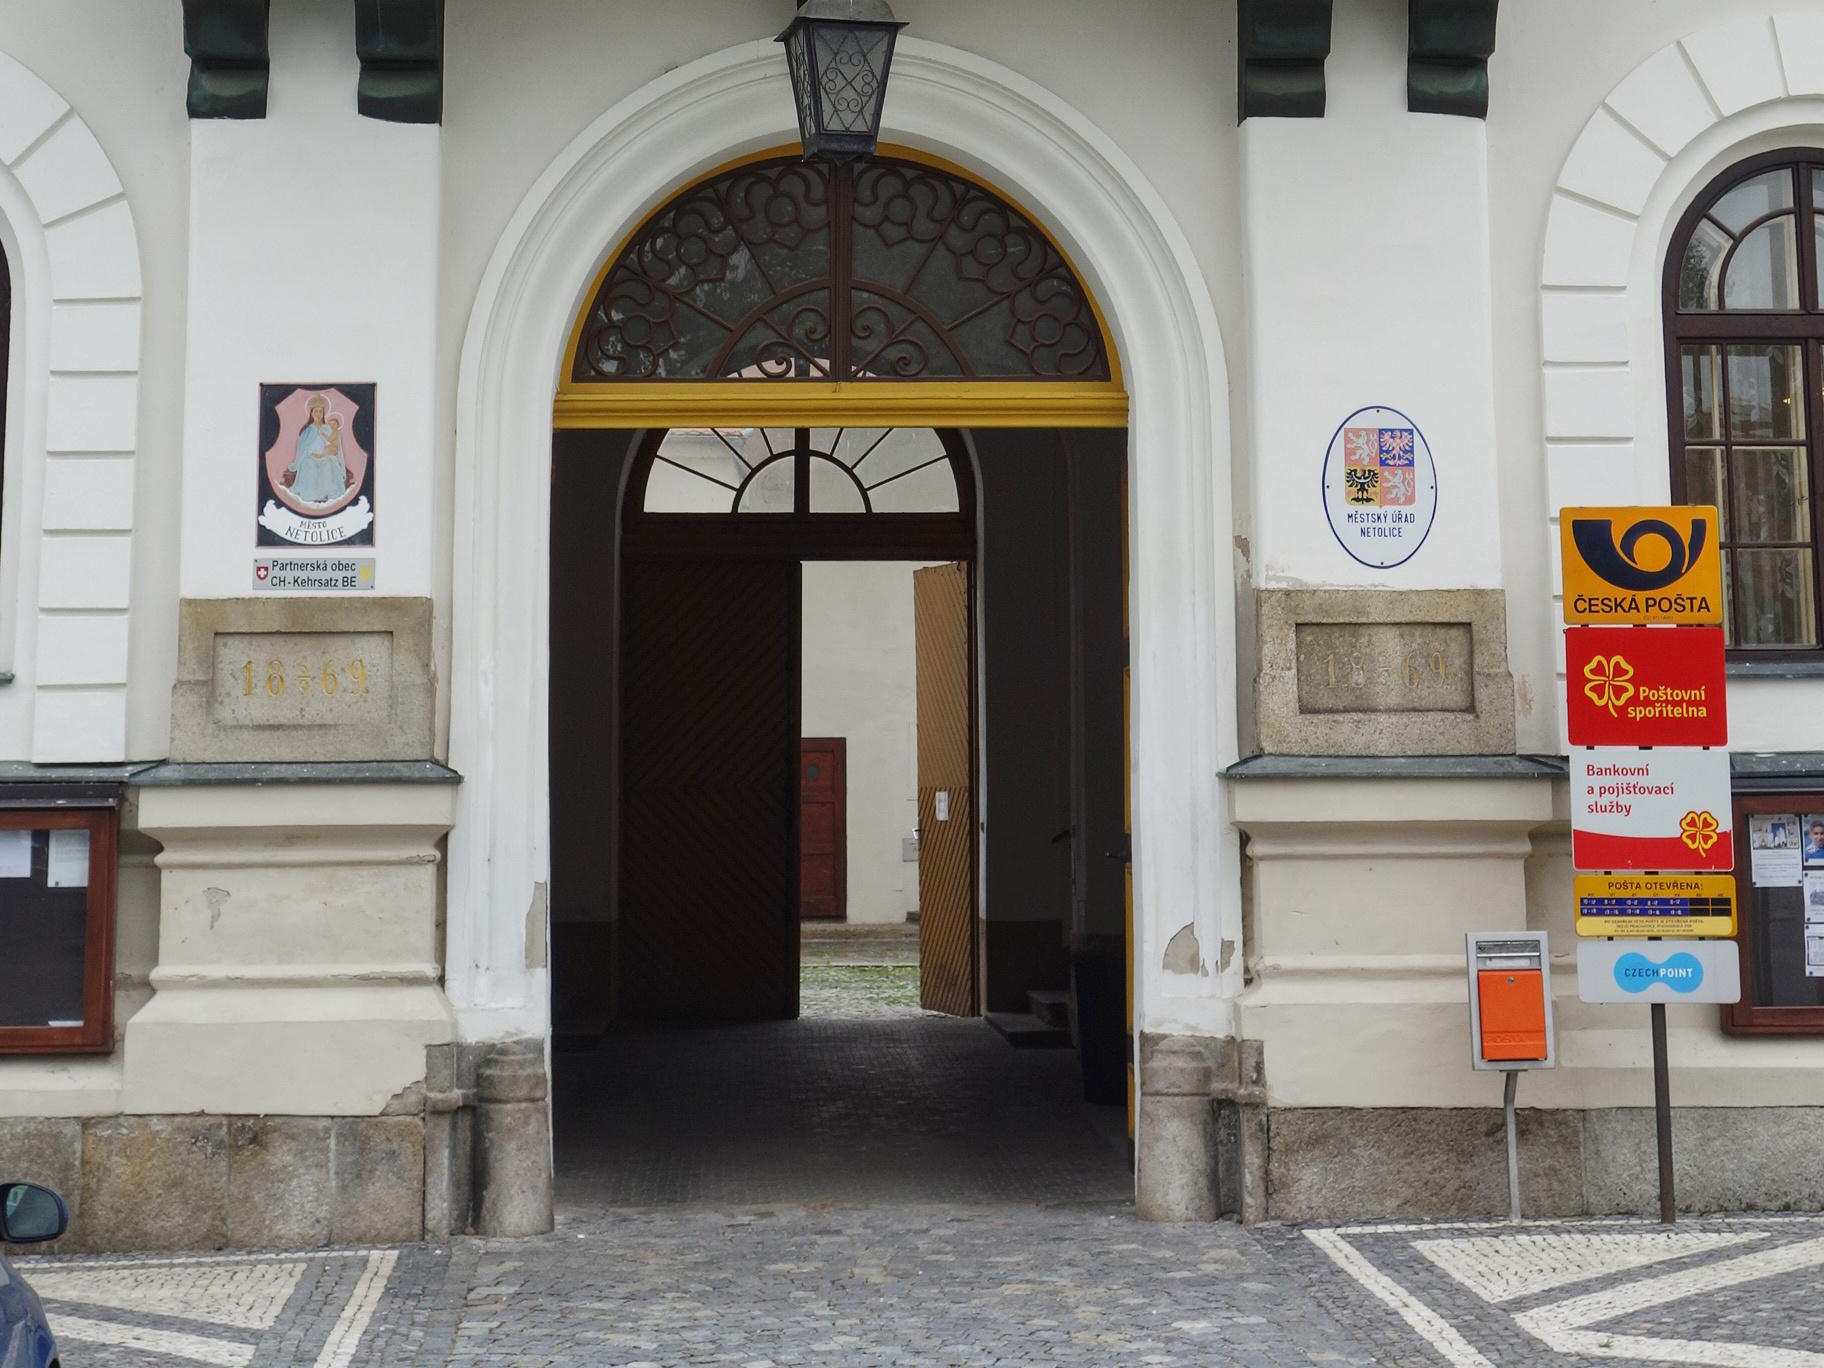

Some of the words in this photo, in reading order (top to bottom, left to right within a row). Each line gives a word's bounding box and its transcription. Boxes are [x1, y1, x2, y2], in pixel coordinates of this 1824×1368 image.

[299, 519, 327, 529] MĚSTO
[1347, 510, 1388, 524] MĚSTSKÝ
[1391, 510, 1415, 524] ÚŘAD
[285, 526, 346, 543] NETOLICE
[1360, 527, 1403, 538] NETOLICE
[272, 560, 328, 572] Partnerská
[331, 560, 356, 572] obec
[342, 576, 357, 588] BE
[1573, 594, 1640, 614] ČESKÁ
[1645, 593, 1711, 613] POŠTA
[1639, 685, 1706, 701] Poštovní
[1627, 702, 1707, 721] spořitelna
[1586, 763, 1650, 776] Bankovní
[1586, 785, 1595, 795] a
[1599, 781, 1674, 798] pojišťovací
[1587, 800, 1632, 816] služby
[1608, 879, 1641, 890] POŠTA
[1645, 879, 1703, 890] OTEVŘENA:
